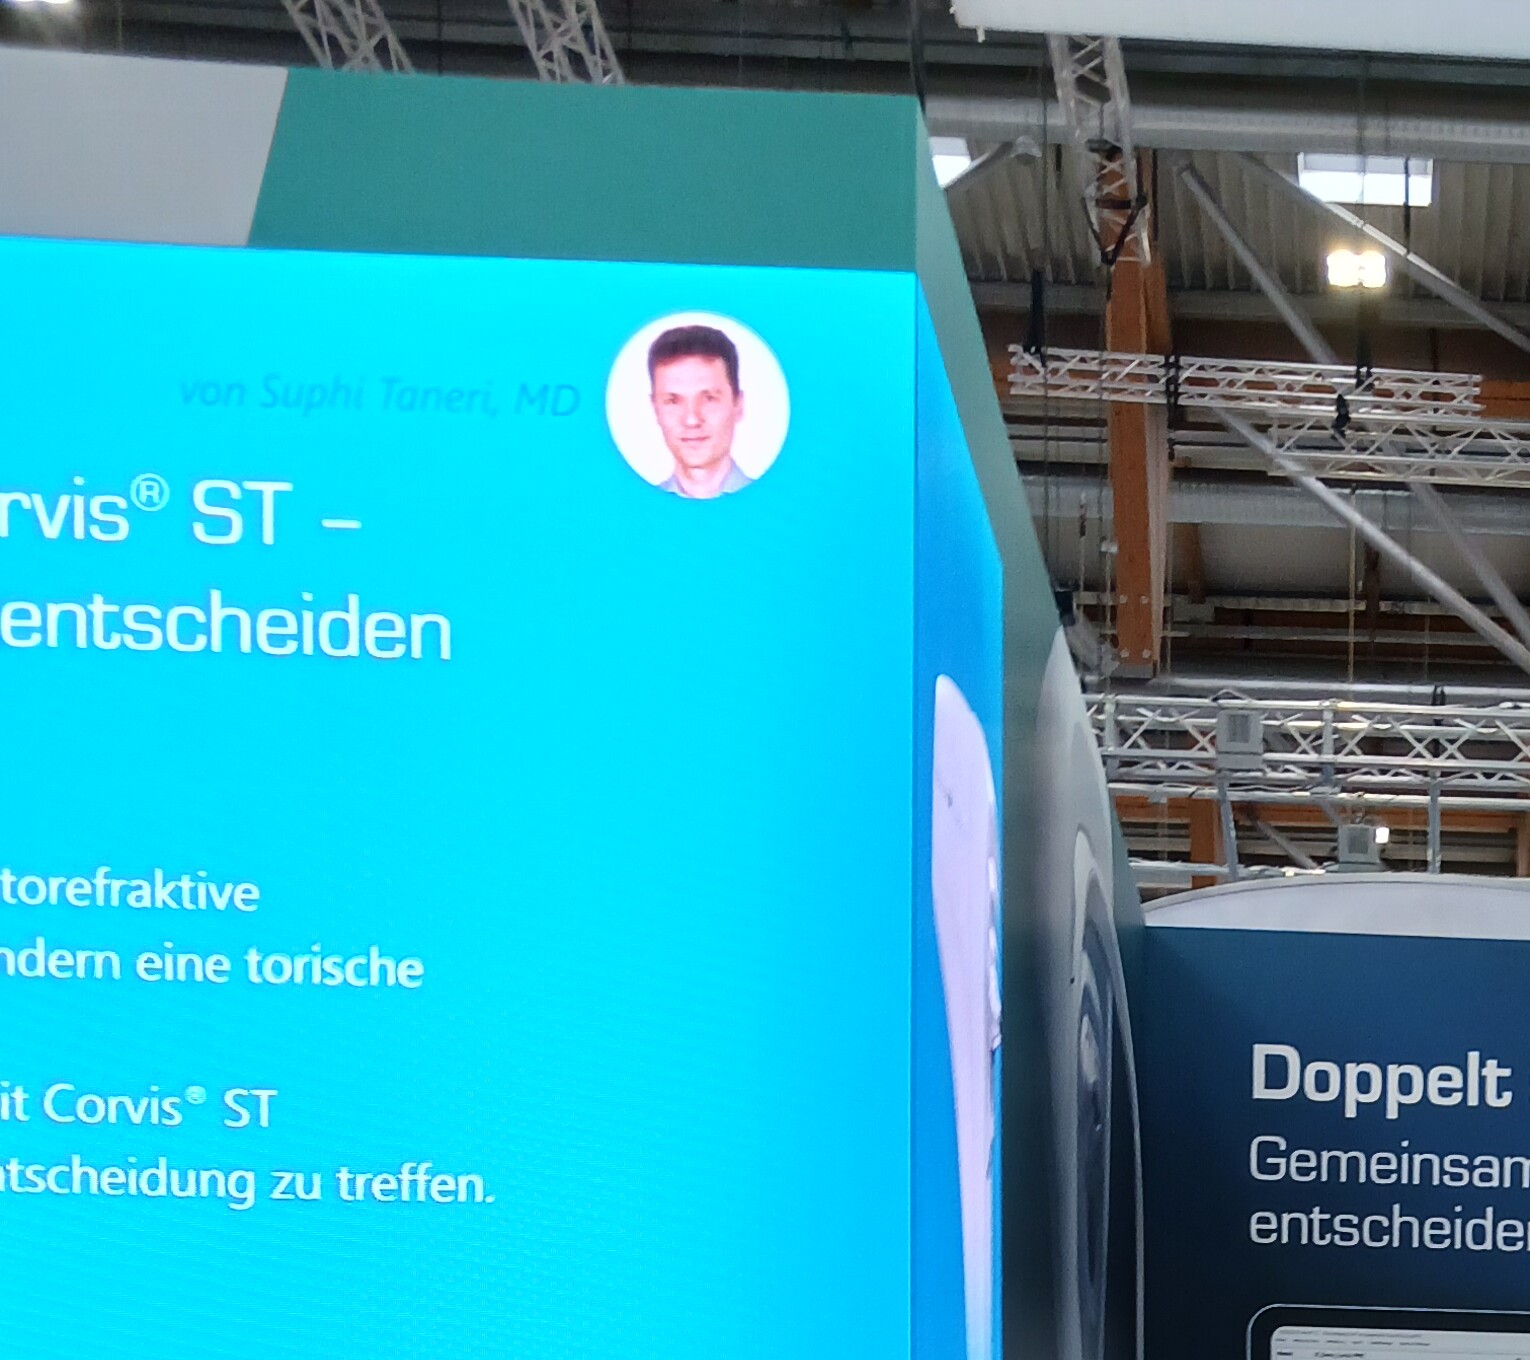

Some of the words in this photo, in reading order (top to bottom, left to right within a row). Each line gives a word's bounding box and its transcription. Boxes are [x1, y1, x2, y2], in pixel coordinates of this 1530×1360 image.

[179, 379, 246, 406] von
[258, 372, 367, 417] Suphi
[513, 382, 582, 417] MD
[191, 479, 294, 546] ST
[1, 590, 452, 660] entscheiden
[0, 866, 261, 913] torefraktive
[136, 941, 231, 984] eine
[244, 942, 425, 989] torische
[1252, 1043, 1513, 1118] Doppelt
[223, 1087, 279, 1128] ST
[271, 1171, 322, 1201] zu
[337, 1162, 497, 1204] treffen.
